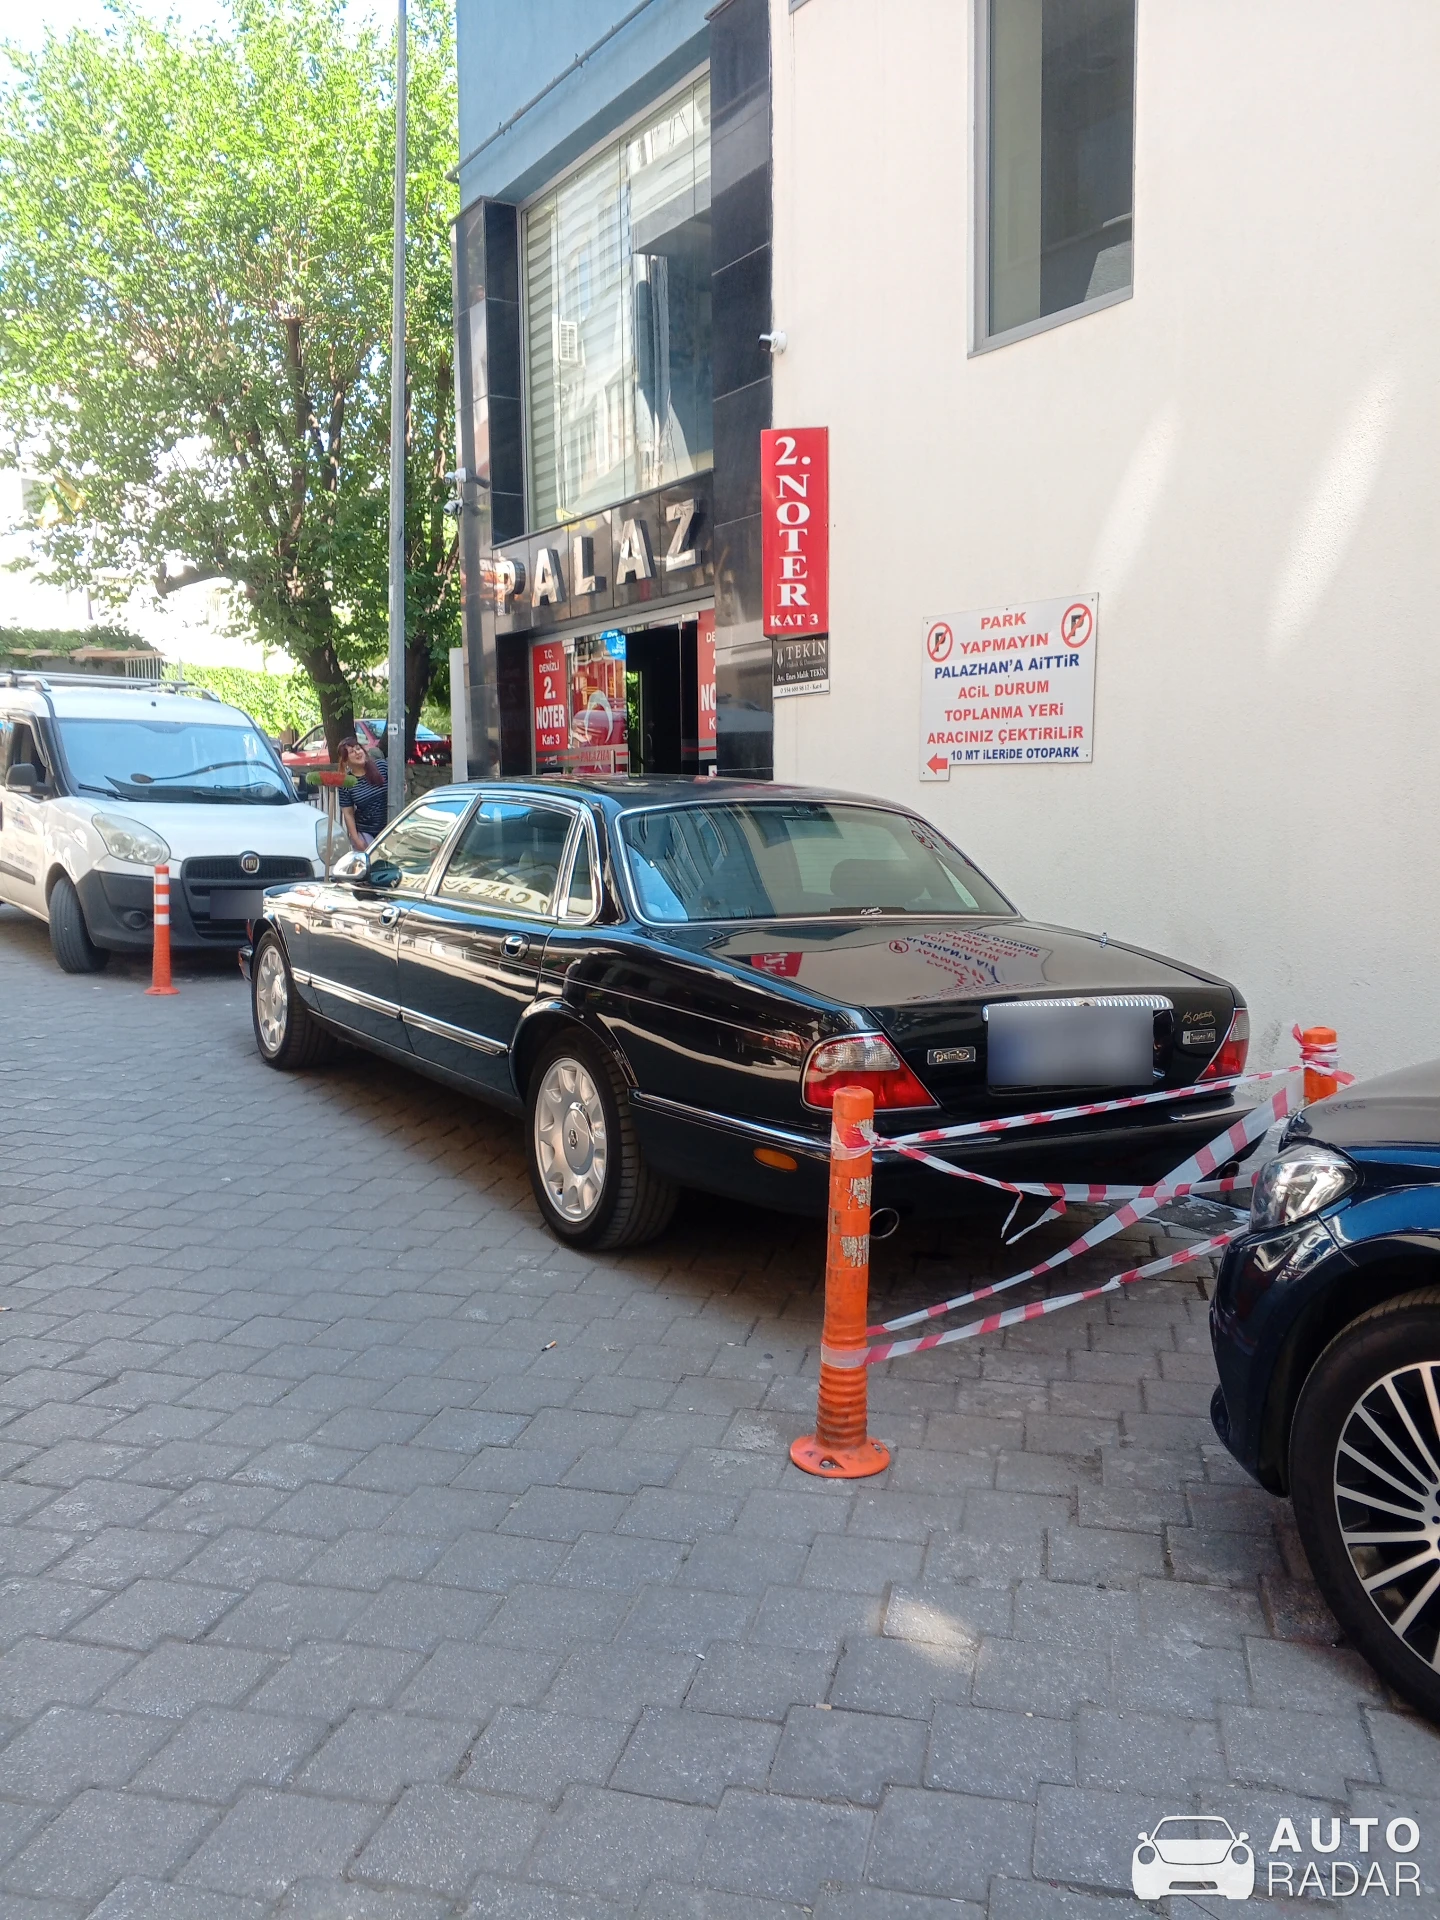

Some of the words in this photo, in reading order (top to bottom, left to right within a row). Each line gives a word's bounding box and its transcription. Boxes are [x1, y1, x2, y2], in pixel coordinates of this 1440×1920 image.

[774, 436, 811, 466] 2.
[776, 473, 811, 607] NOTER
[496, 498, 699, 616] PALAZ
[770, 614, 805, 627] KAT
[810, 613, 819, 625] 3
[980, 612, 1027, 630] PARK
[786, 639, 826, 660] TEKİN
[960, 633, 1049, 655] YAPMAYIN
[934, 659, 1024, 679] PALAZHAN'A
[543, 676, 556, 699] 2.
[994, 680, 1049, 697] DURUM
[536, 704, 566, 730] NOTER
[944, 705, 1023, 722] TOPLANMA
[555, 734, 560, 745] 3
[927, 730, 993, 745] ARACINIZ
[951, 750, 962, 761] 10
[965, 749, 980, 760] MT
[1026, 746, 1080, 759] OTOPARK
[245, 859, 257, 869] FIAT
